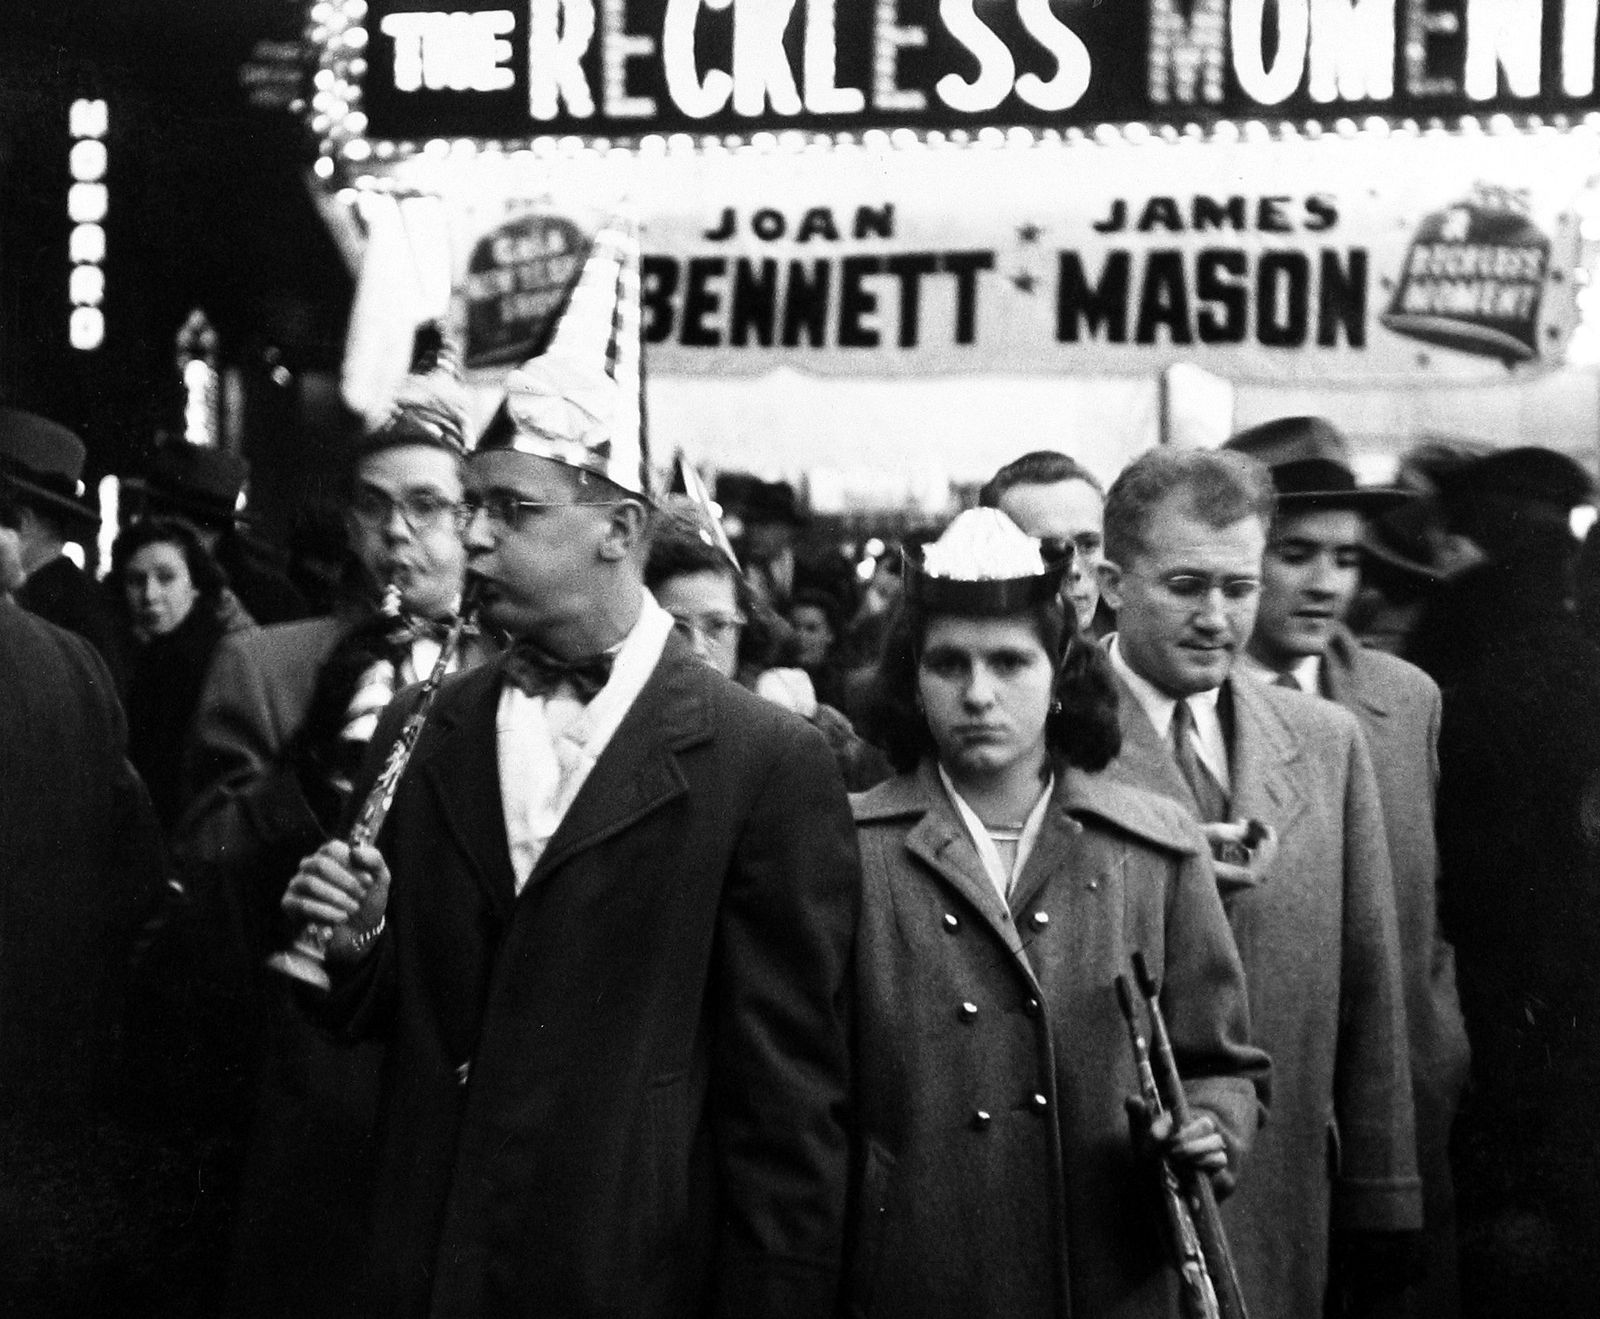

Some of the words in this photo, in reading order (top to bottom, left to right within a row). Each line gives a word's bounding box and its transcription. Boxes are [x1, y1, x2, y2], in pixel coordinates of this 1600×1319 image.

[380, 10, 516, 92] THE
[527, 0, 1092, 119] RECKLESS
[704, 204, 894, 243] JOAN
[1093, 196, 1339, 234] JAMES
[643, 252, 994, 348] BENNETT
[1056, 248, 1367, 349] MASON
